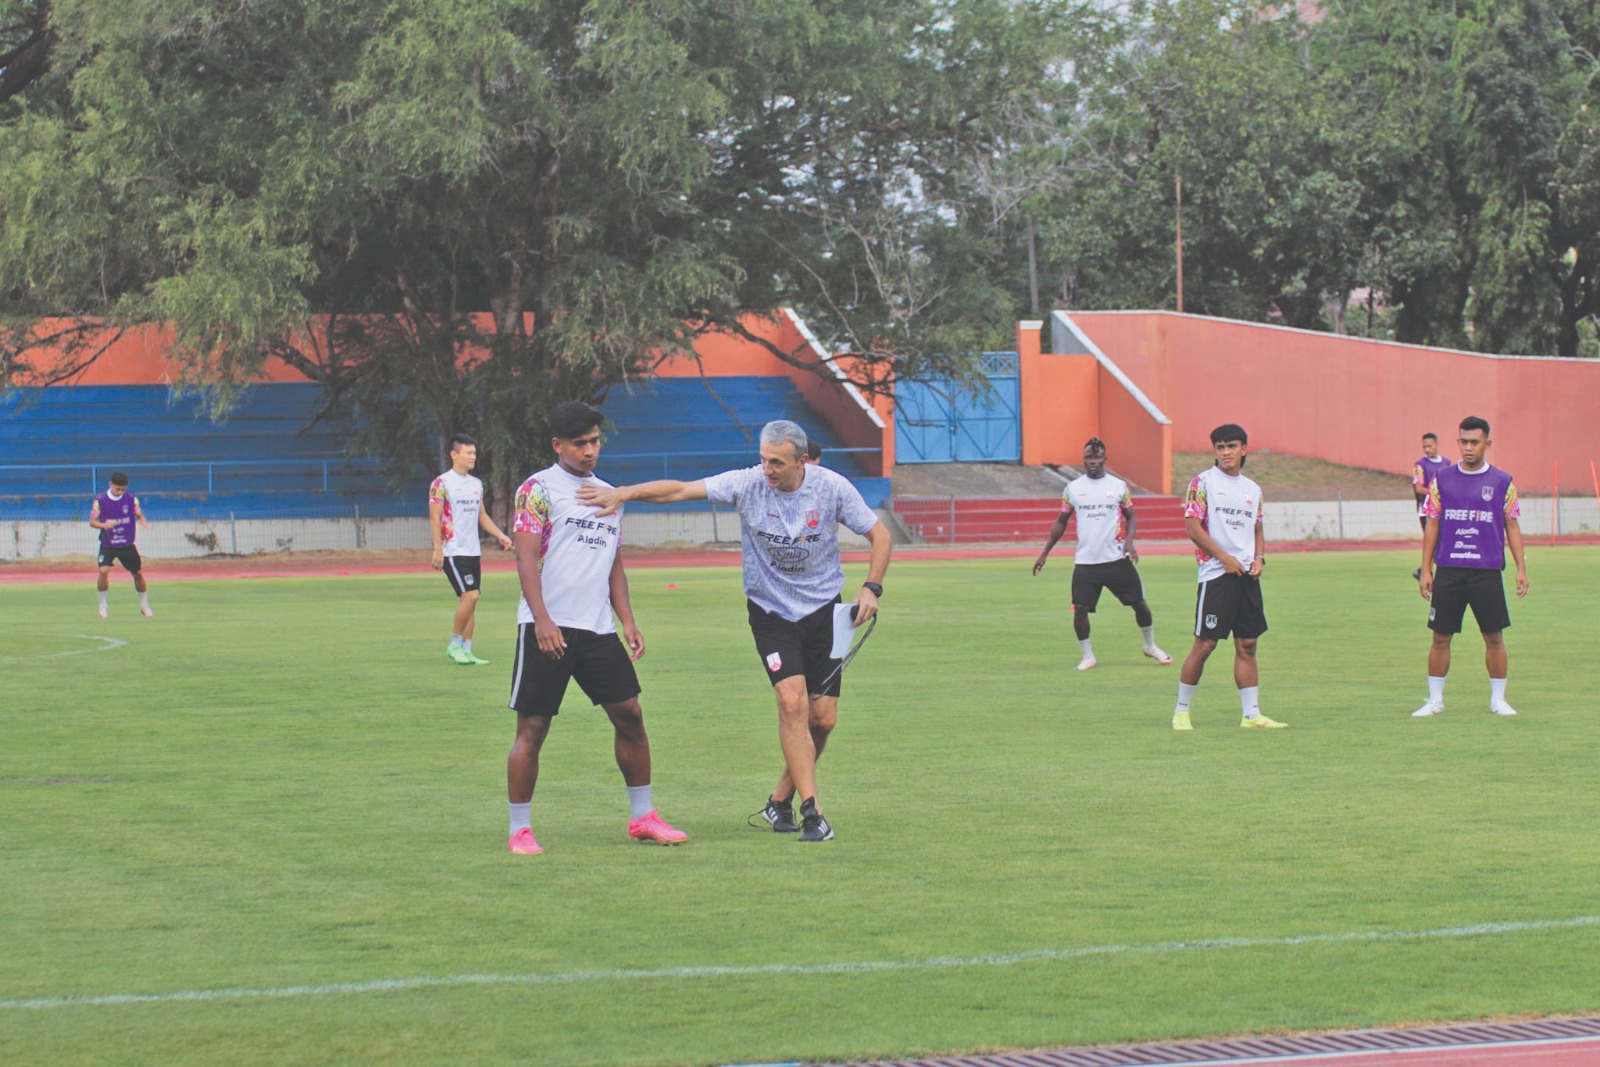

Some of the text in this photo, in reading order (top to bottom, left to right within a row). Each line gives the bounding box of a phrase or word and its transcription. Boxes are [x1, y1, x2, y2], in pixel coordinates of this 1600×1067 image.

[1215, 506, 1236, 515] FREE
[1445, 509, 1494, 523] FREE FIRE
[565, 517, 595, 530] FREE
[577, 534, 607, 548] Aladin
[757, 530, 821, 545] FREE FIRE
[1450, 551, 1481, 559] smartfren
[770, 561, 804, 573] Aladin
